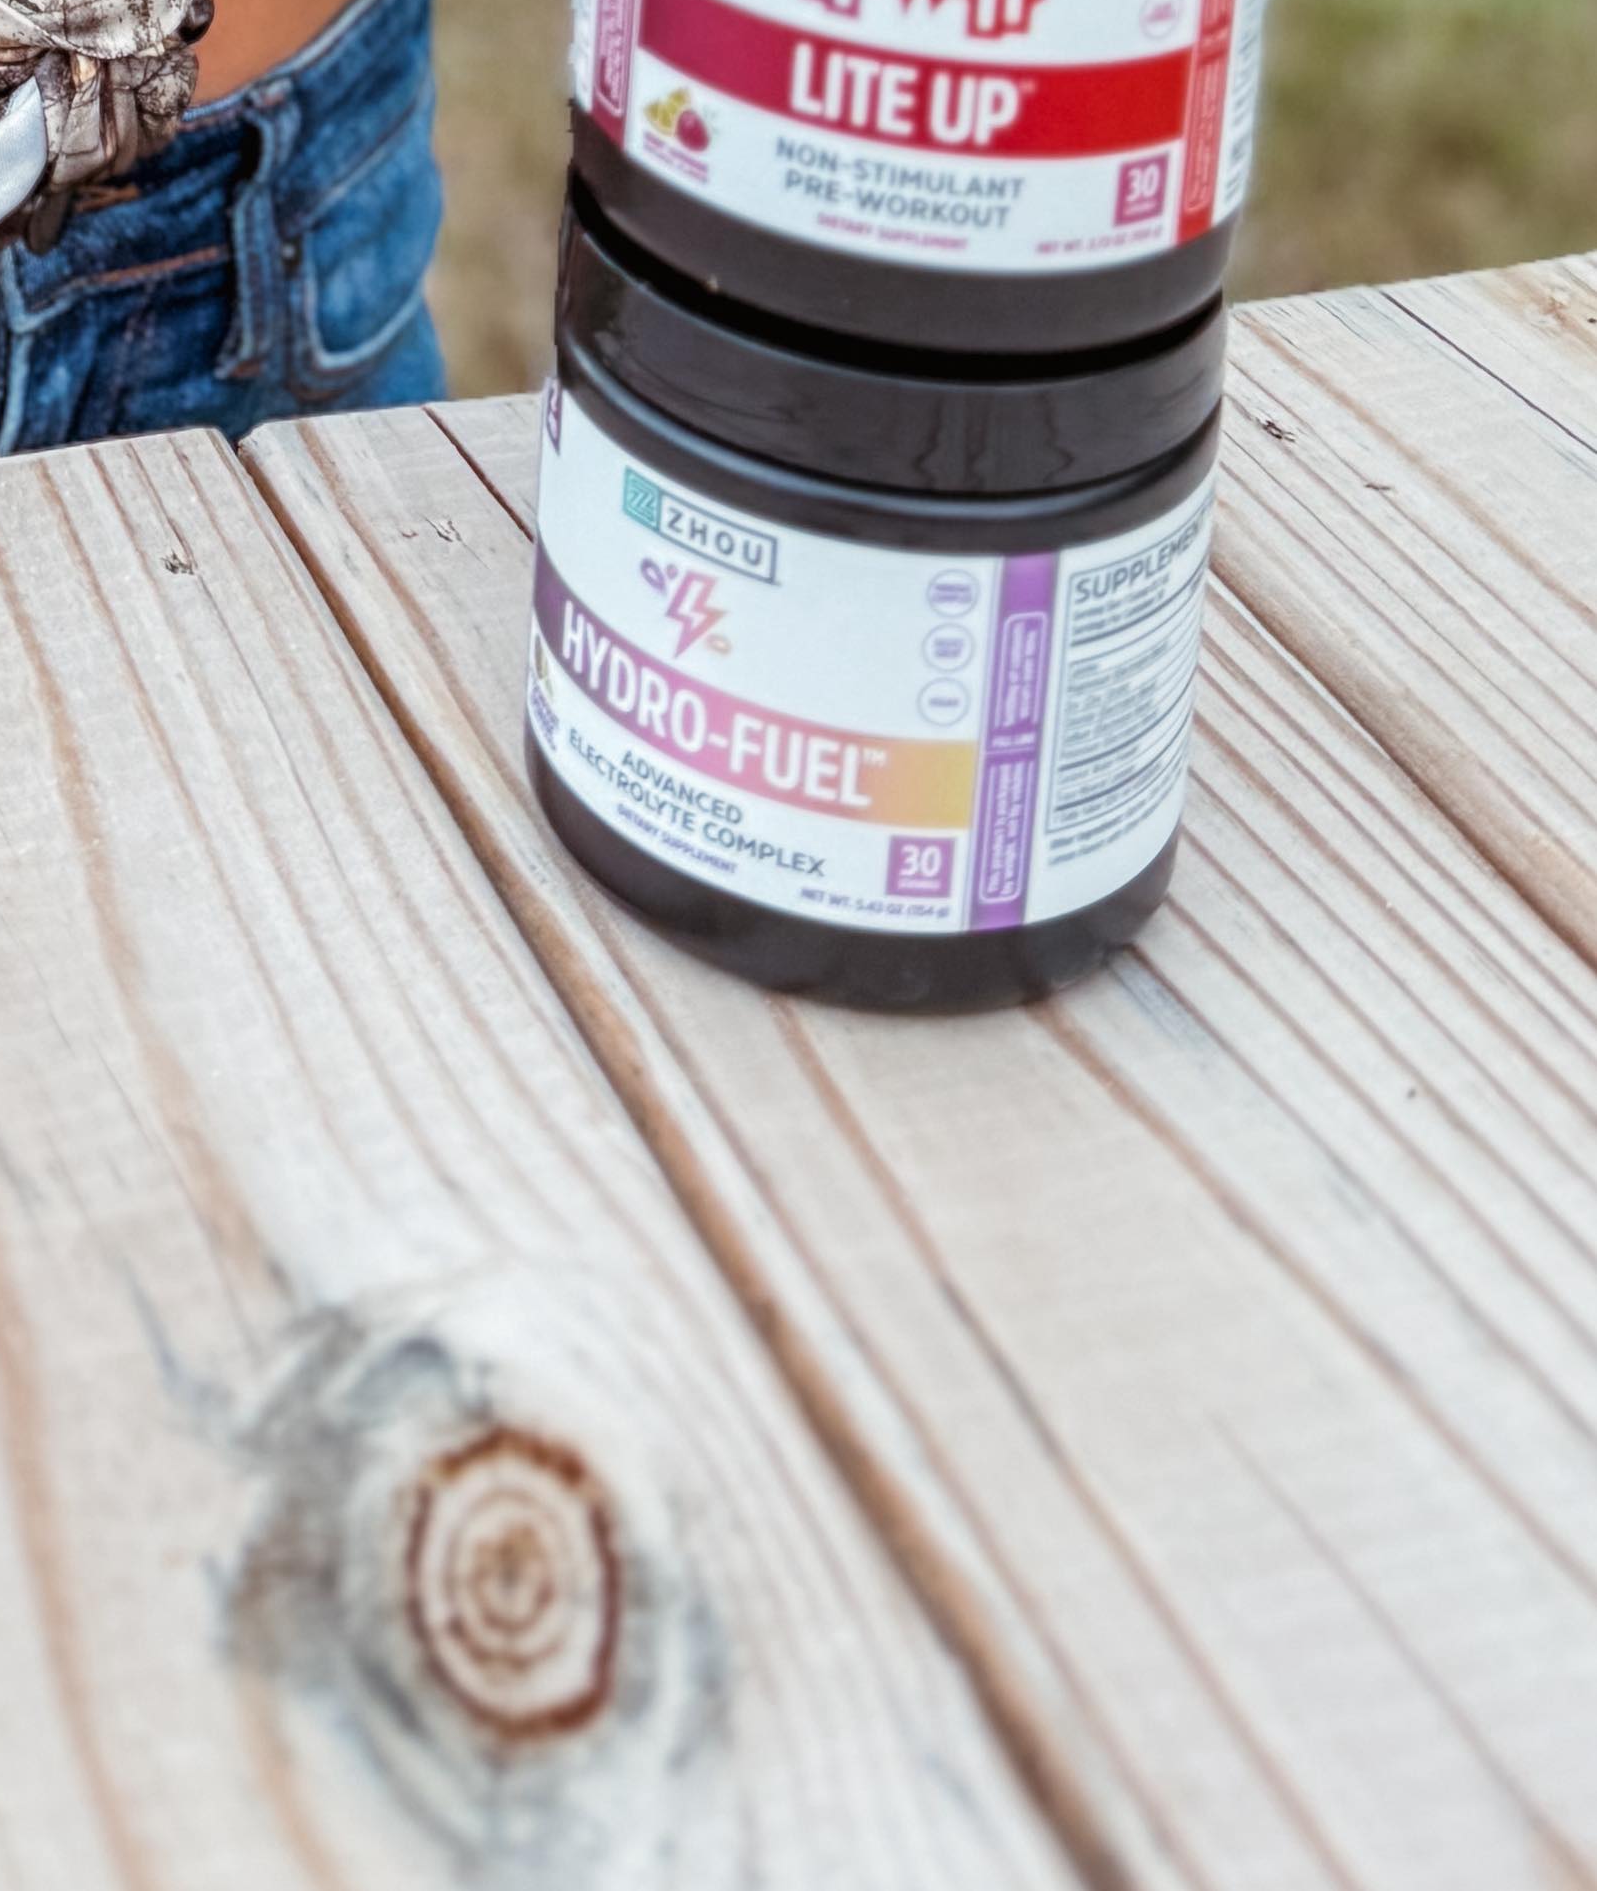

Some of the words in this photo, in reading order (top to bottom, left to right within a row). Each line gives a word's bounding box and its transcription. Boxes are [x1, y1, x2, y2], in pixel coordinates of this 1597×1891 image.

[789, 40, 919, 137] LITE
[928, 70, 1021, 146] UP
[775, 136, 1025, 199] NON-STIMULANT
[783, 167, 1011, 228] PRE-WORKOUT
[1126, 163, 1161, 203] 30
[666, 506, 763, 567] ZHOU
[568, 727, 696, 832] ELECTROLYTE
[702, 820, 828, 877] COMPLEX
[621, 749, 743, 826] ADVANCED
[661, 831, 739, 874] SUPPLEMENT
[898, 843, 943, 878] 30
